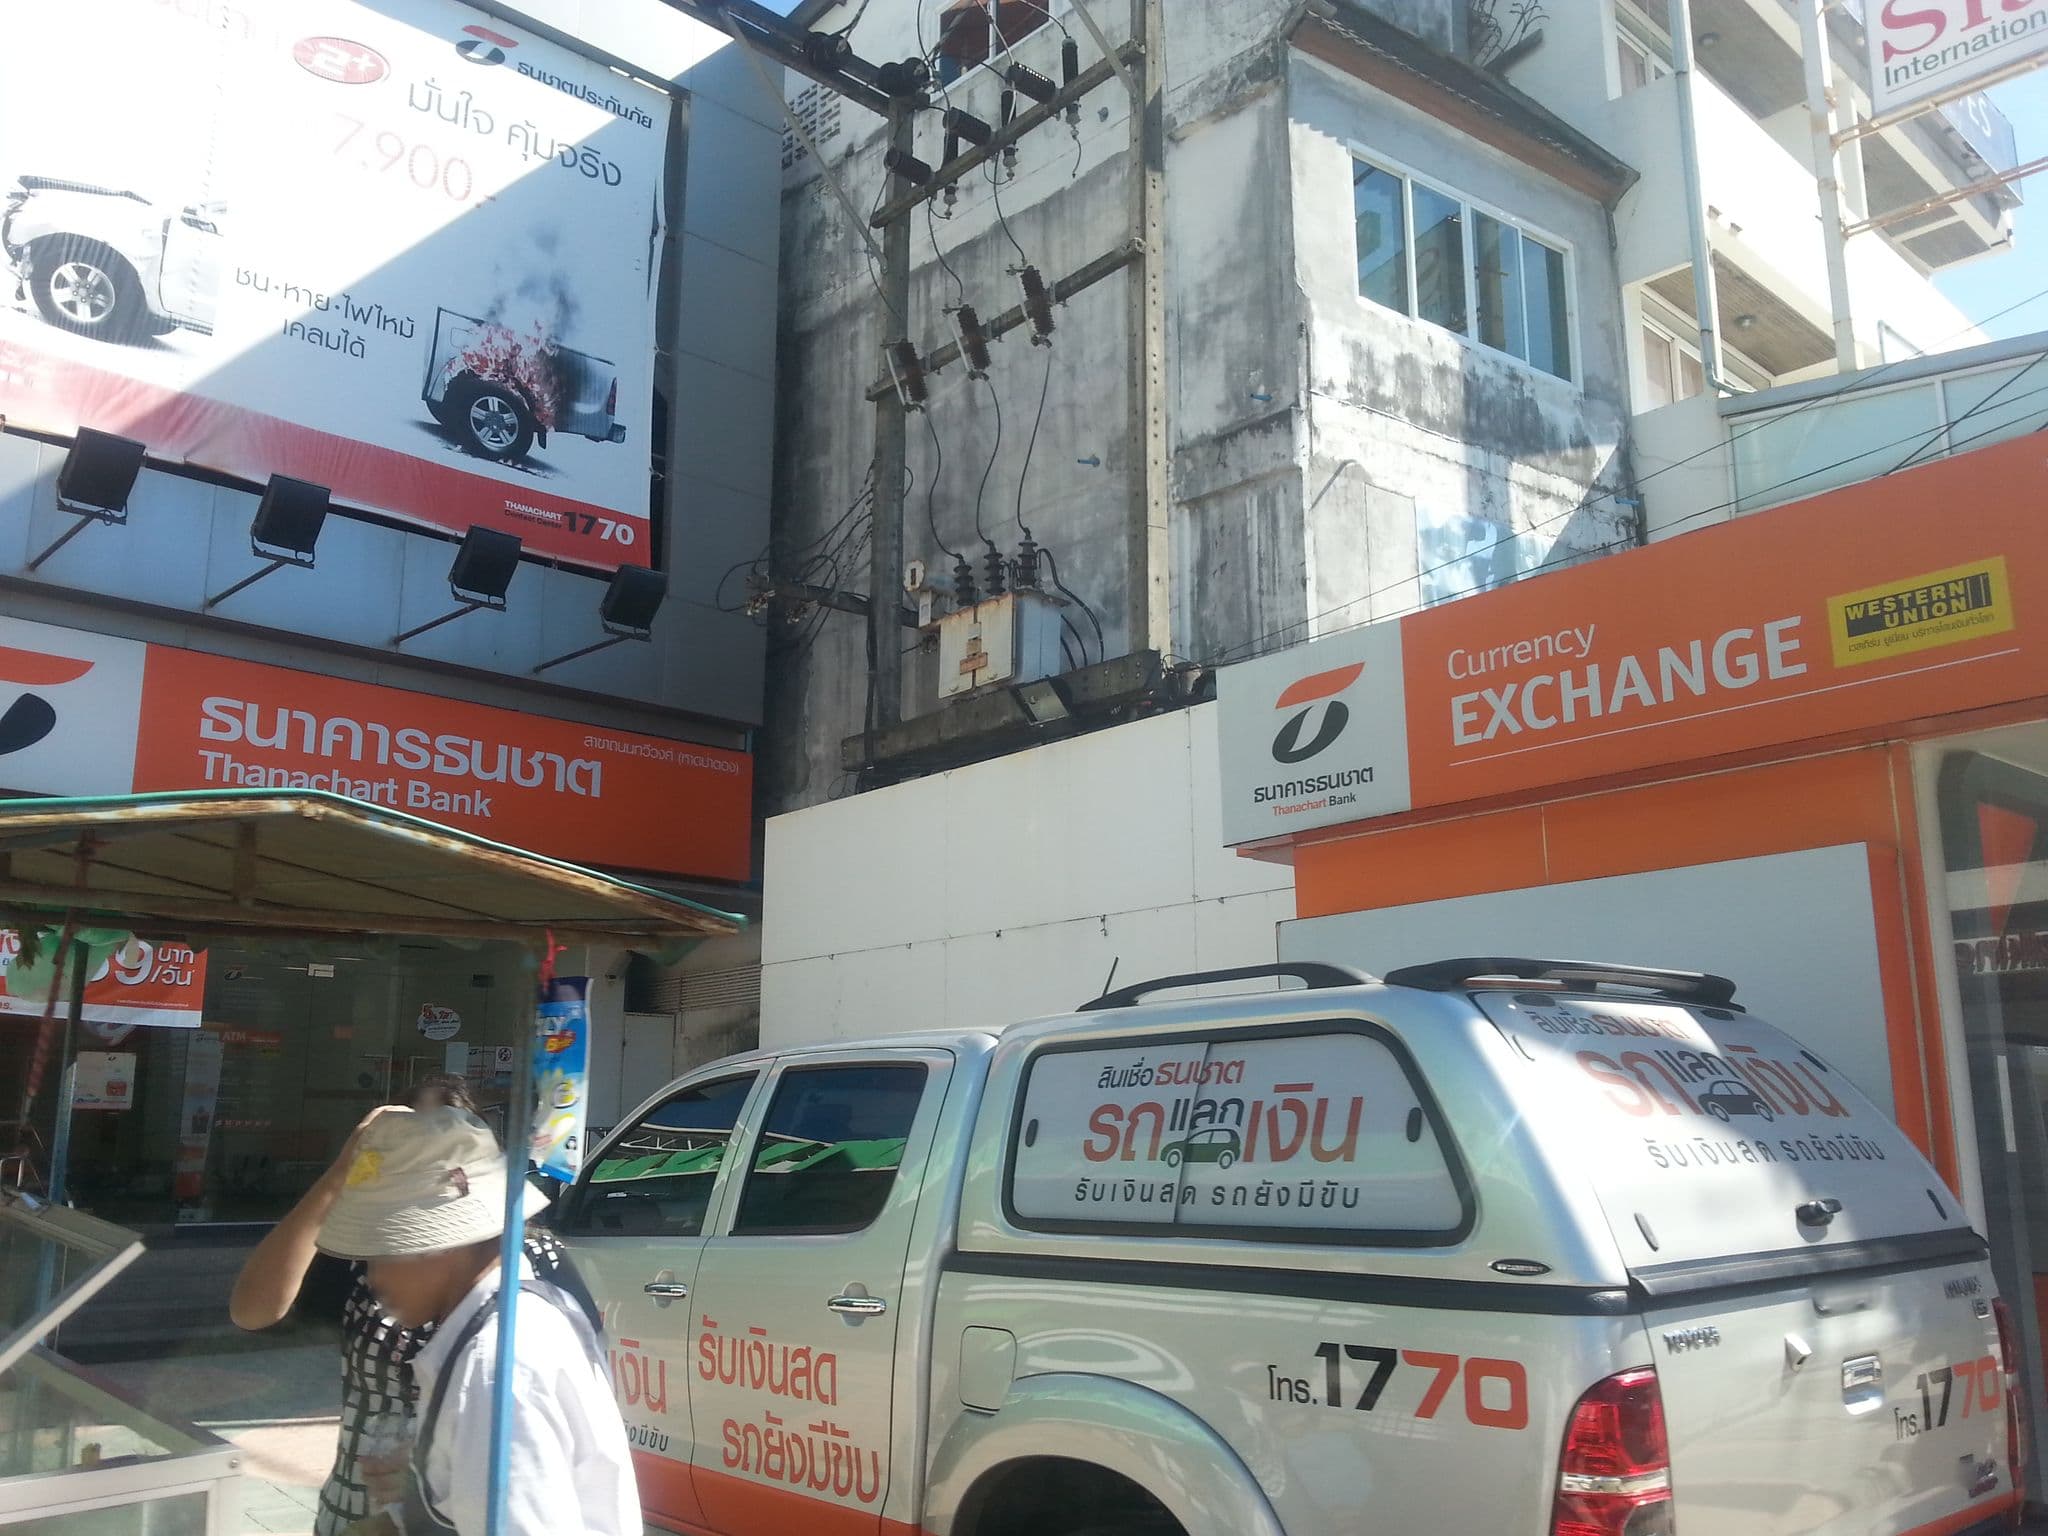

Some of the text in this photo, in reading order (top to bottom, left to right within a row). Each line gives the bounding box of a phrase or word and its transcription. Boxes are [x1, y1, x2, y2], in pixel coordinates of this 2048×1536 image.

[517, 61, 653, 129] ธนชาตประกันภัย
[408, 77, 622, 187] มั่นใจ คุ้มจริง
[282, 318, 366, 359] เคลมได้
[504, 500, 563, 521] THANACHART
[564, 511, 635, 546] 1770
[1846, 580, 1965, 621] WESTERN
[1884, 597, 1967, 629] UNION
[1446, 622, 1597, 682] Currency
[1450, 615, 1808, 748] EXCHANGE
[199, 696, 602, 798] ธนาคารธนชาต
[198, 749, 492, 818] Thanachart Bank
[1254, 766, 1374, 803] ธนาคารธนชาต
[1272, 792, 1357, 816] Thanachart Bank
[157, 947, 195, 965] บาท
[1074, 1177, 1360, 1209] รับเงินสด รถยังมีขับ
[698, 1314, 837, 1406] รับเงินสด
[722, 1410, 880, 1503] รถยังมีขับ
